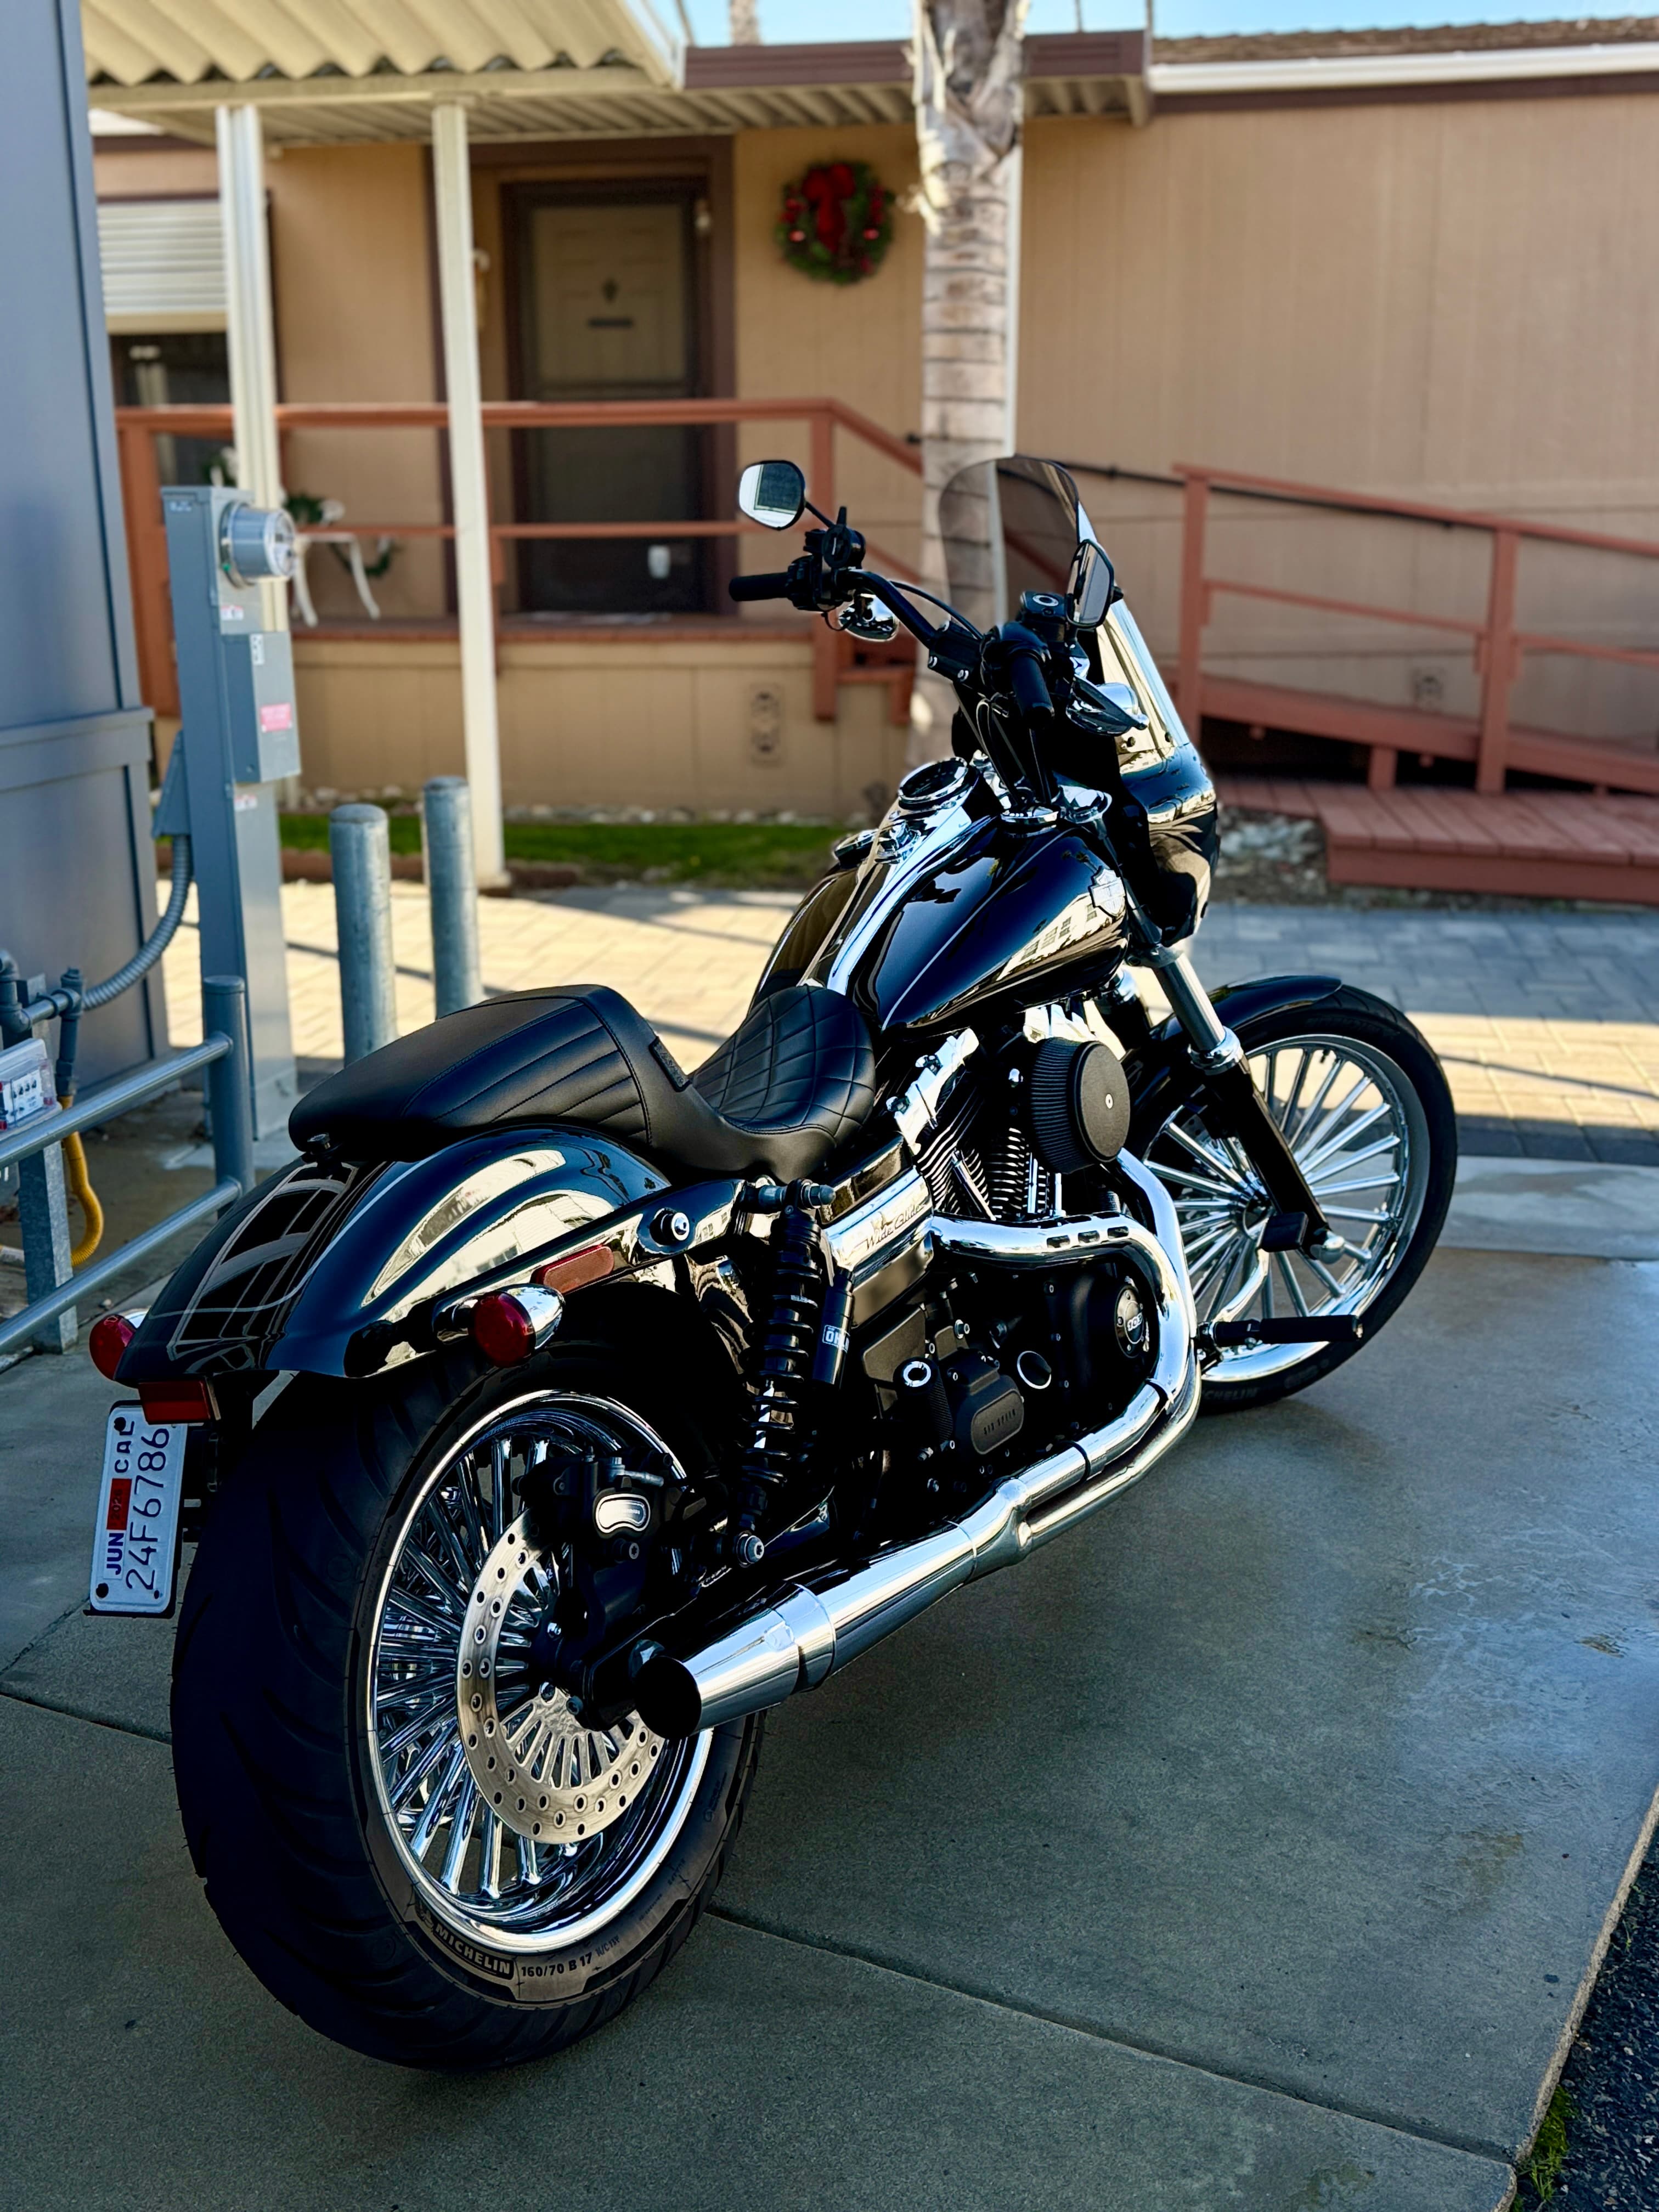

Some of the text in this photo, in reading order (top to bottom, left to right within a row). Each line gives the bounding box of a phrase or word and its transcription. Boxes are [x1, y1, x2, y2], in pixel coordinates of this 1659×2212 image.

[861, 1202, 927, 1251] Wide Glide
[114, 1420, 135, 1473] CAL
[126, 1428, 170, 1590] 24F6786
[106, 1533, 125, 1576] JUN
[435, 1922, 511, 1975] MICHELIN
[521, 1962, 565, 1977] 160/70
[568, 1959, 577, 1971] B
[579, 1951, 592, 1967] 17
